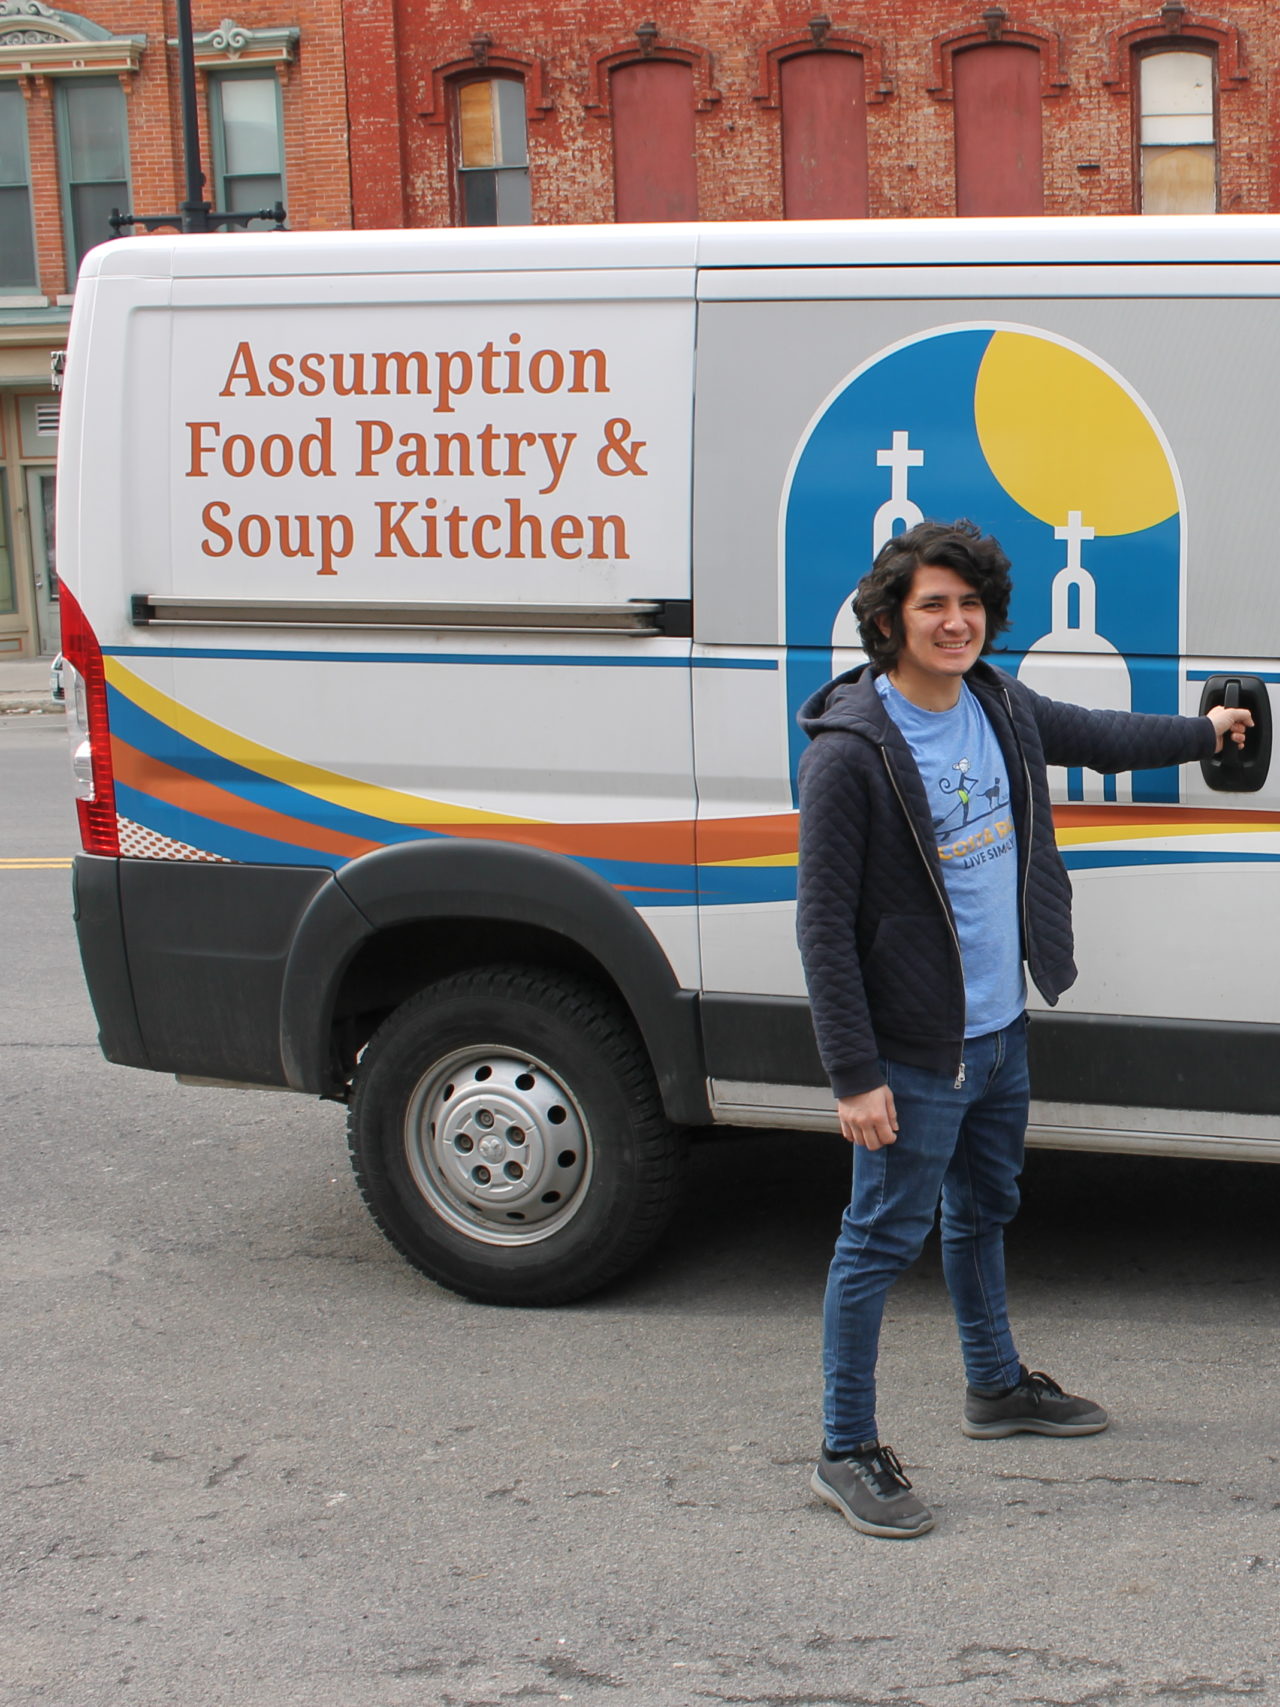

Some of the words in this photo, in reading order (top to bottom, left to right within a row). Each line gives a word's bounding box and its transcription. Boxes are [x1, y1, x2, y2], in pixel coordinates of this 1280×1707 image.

[219, 333, 611, 413] Assumption
[185, 417, 337, 478] Food
[355, 417, 577, 496] Pantry
[597, 416, 649, 478] &
[201, 500, 355, 577] Soup
[375, 497, 632, 560] Kitchen
[938, 828, 995, 860] COSTA
[963, 851, 987, 870] LIVE
[986, 834, 1015, 861] SIMLY
